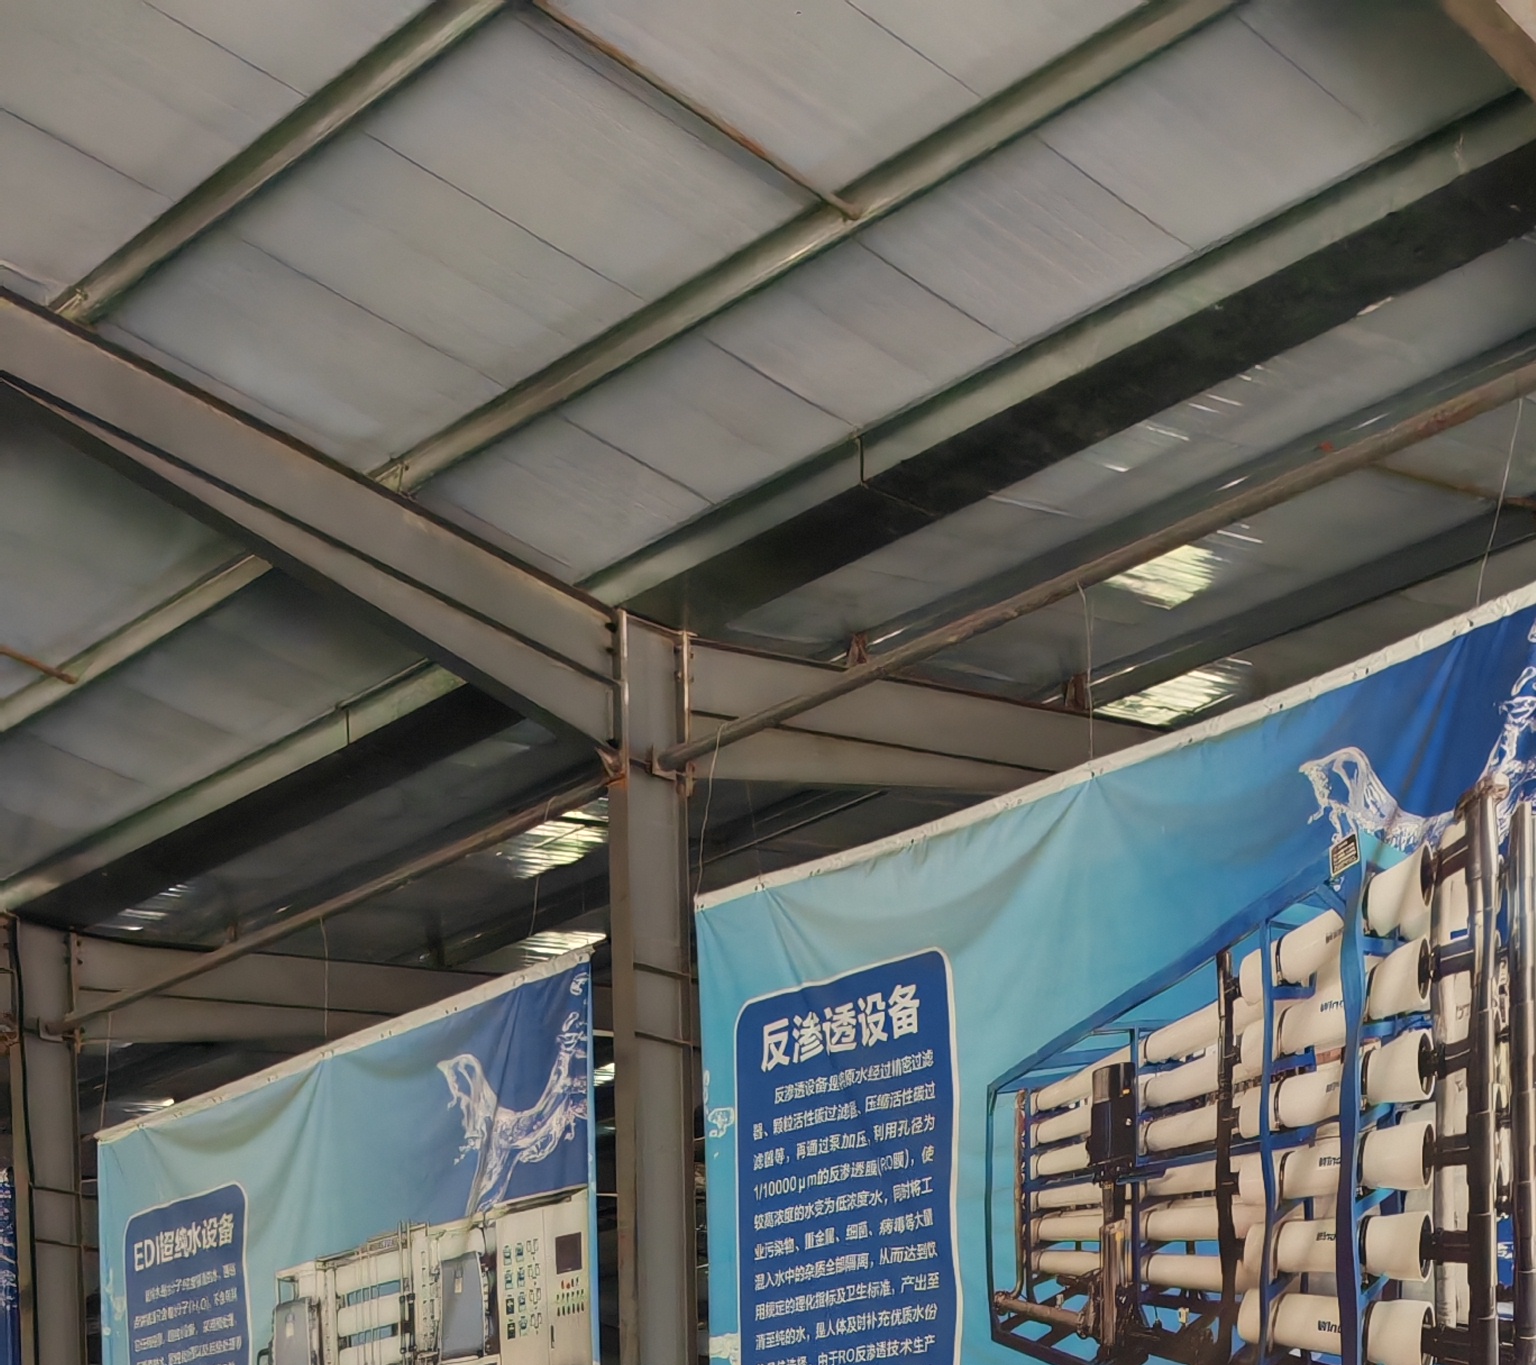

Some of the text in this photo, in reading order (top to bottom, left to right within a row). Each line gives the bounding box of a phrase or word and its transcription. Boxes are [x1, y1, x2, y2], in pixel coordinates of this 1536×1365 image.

[761, 984, 920, 1073] 反渗透设备
[133, 1213, 235, 1272] EDI超纯水设备
